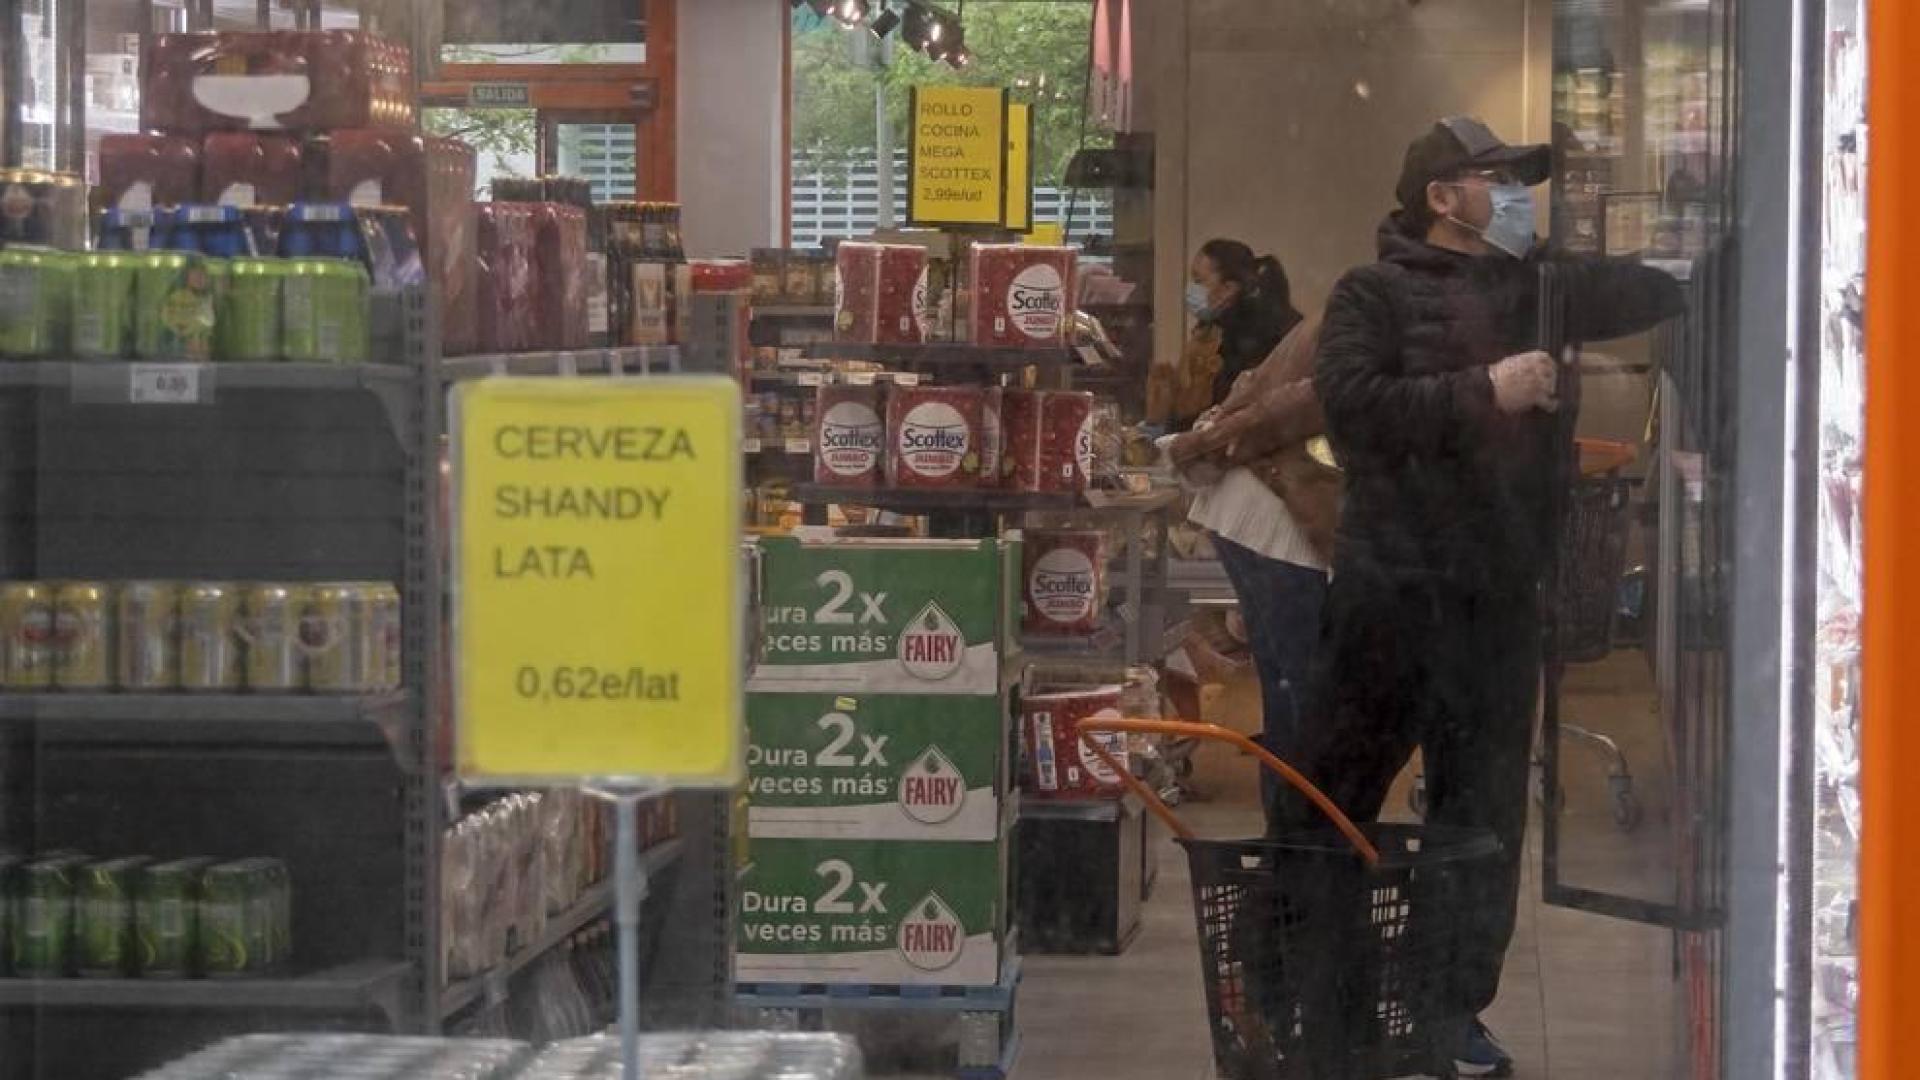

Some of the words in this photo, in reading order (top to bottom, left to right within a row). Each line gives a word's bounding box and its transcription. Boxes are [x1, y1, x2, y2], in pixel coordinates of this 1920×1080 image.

[477, 87, 525, 101] SALIDA
[921, 103, 973, 117] ROLLO
[920, 124, 979, 138] COCINA
[920, 145, 964, 158] MEGA
[920, 167, 992, 181] SCOTTEX
[494, 425, 696, 461] CERVEZA
[823, 427, 880, 448] Scottex
[903, 427, 964, 448] Scottex
[494, 484, 671, 520] SHANDY
[493, 545, 595, 579] LATA
[767, 605, 807, 625] ura
[814, 569, 888, 625] 2x
[766, 635, 821, 652] eces
[905, 634, 958, 662] FAIRY
[516, 666, 681, 703] 0,62e/lat
[815, 712, 888, 767] 2x
[748, 776, 822, 795] veces
[905, 776, 959, 805] FAIRY
[743, 891, 807, 913] Dura
[814, 859, 888, 914] 2x
[744, 923, 821, 942] veces
[904, 924, 957, 953] FAIRY
